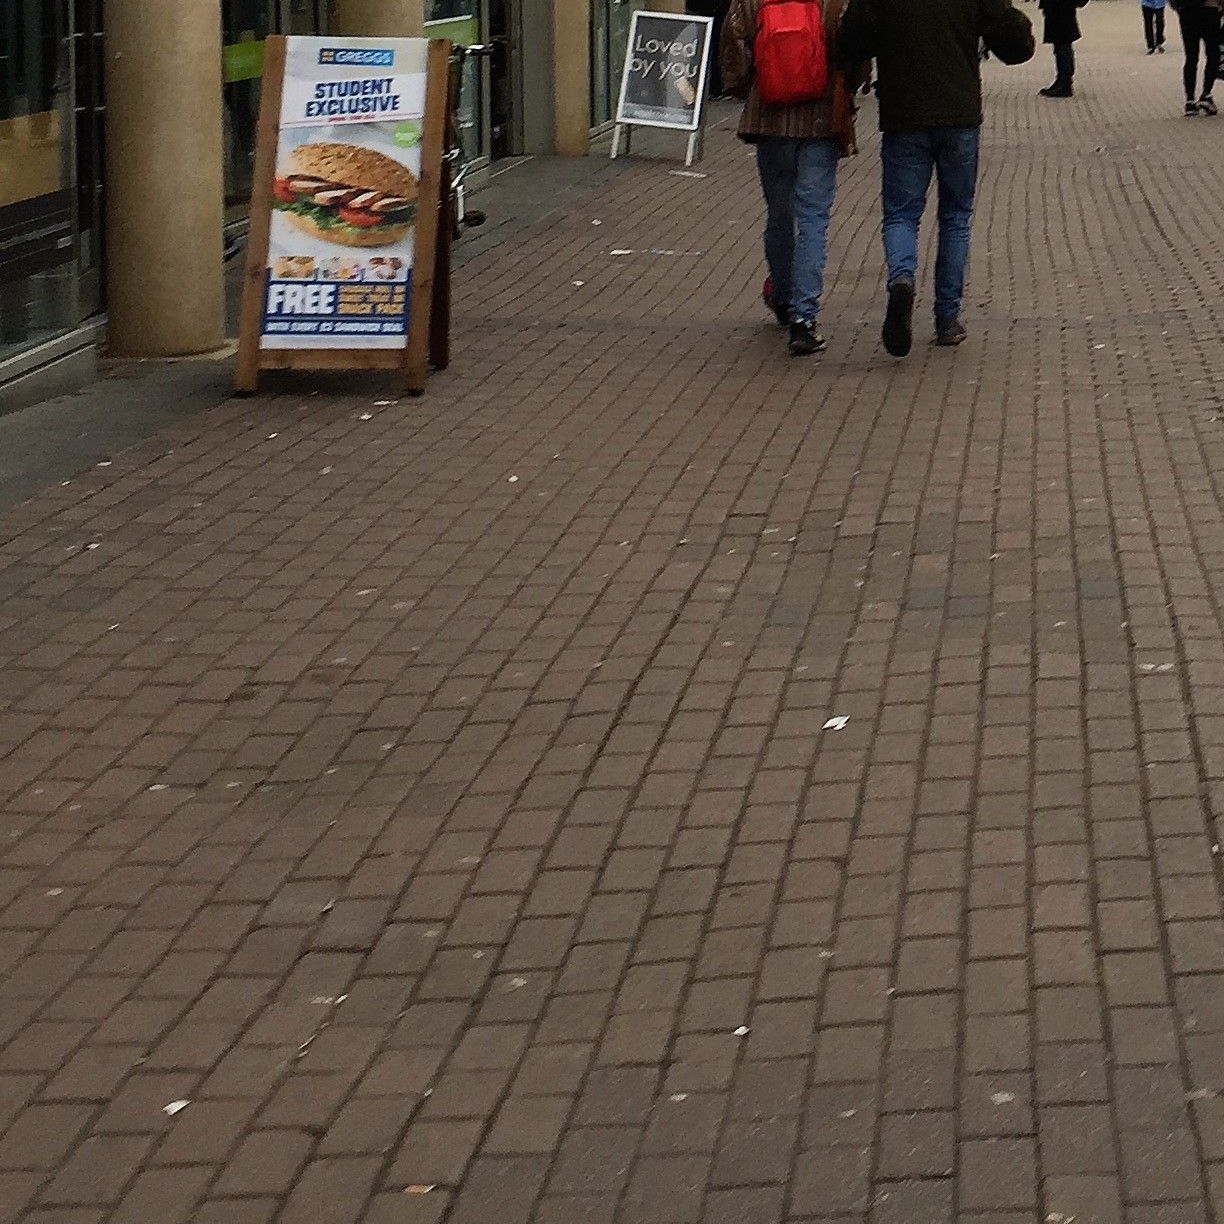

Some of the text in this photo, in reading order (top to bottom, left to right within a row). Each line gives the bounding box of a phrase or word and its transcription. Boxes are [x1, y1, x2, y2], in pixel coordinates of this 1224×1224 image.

[335, 50, 392, 64] GREGGS
[635, 34, 698, 58] Loved
[659, 60, 698, 80] you
[315, 78, 394, 99] STUDENT
[305, 94, 401, 118] EXCLUSIVE
[266, 284, 337, 315] FREE
